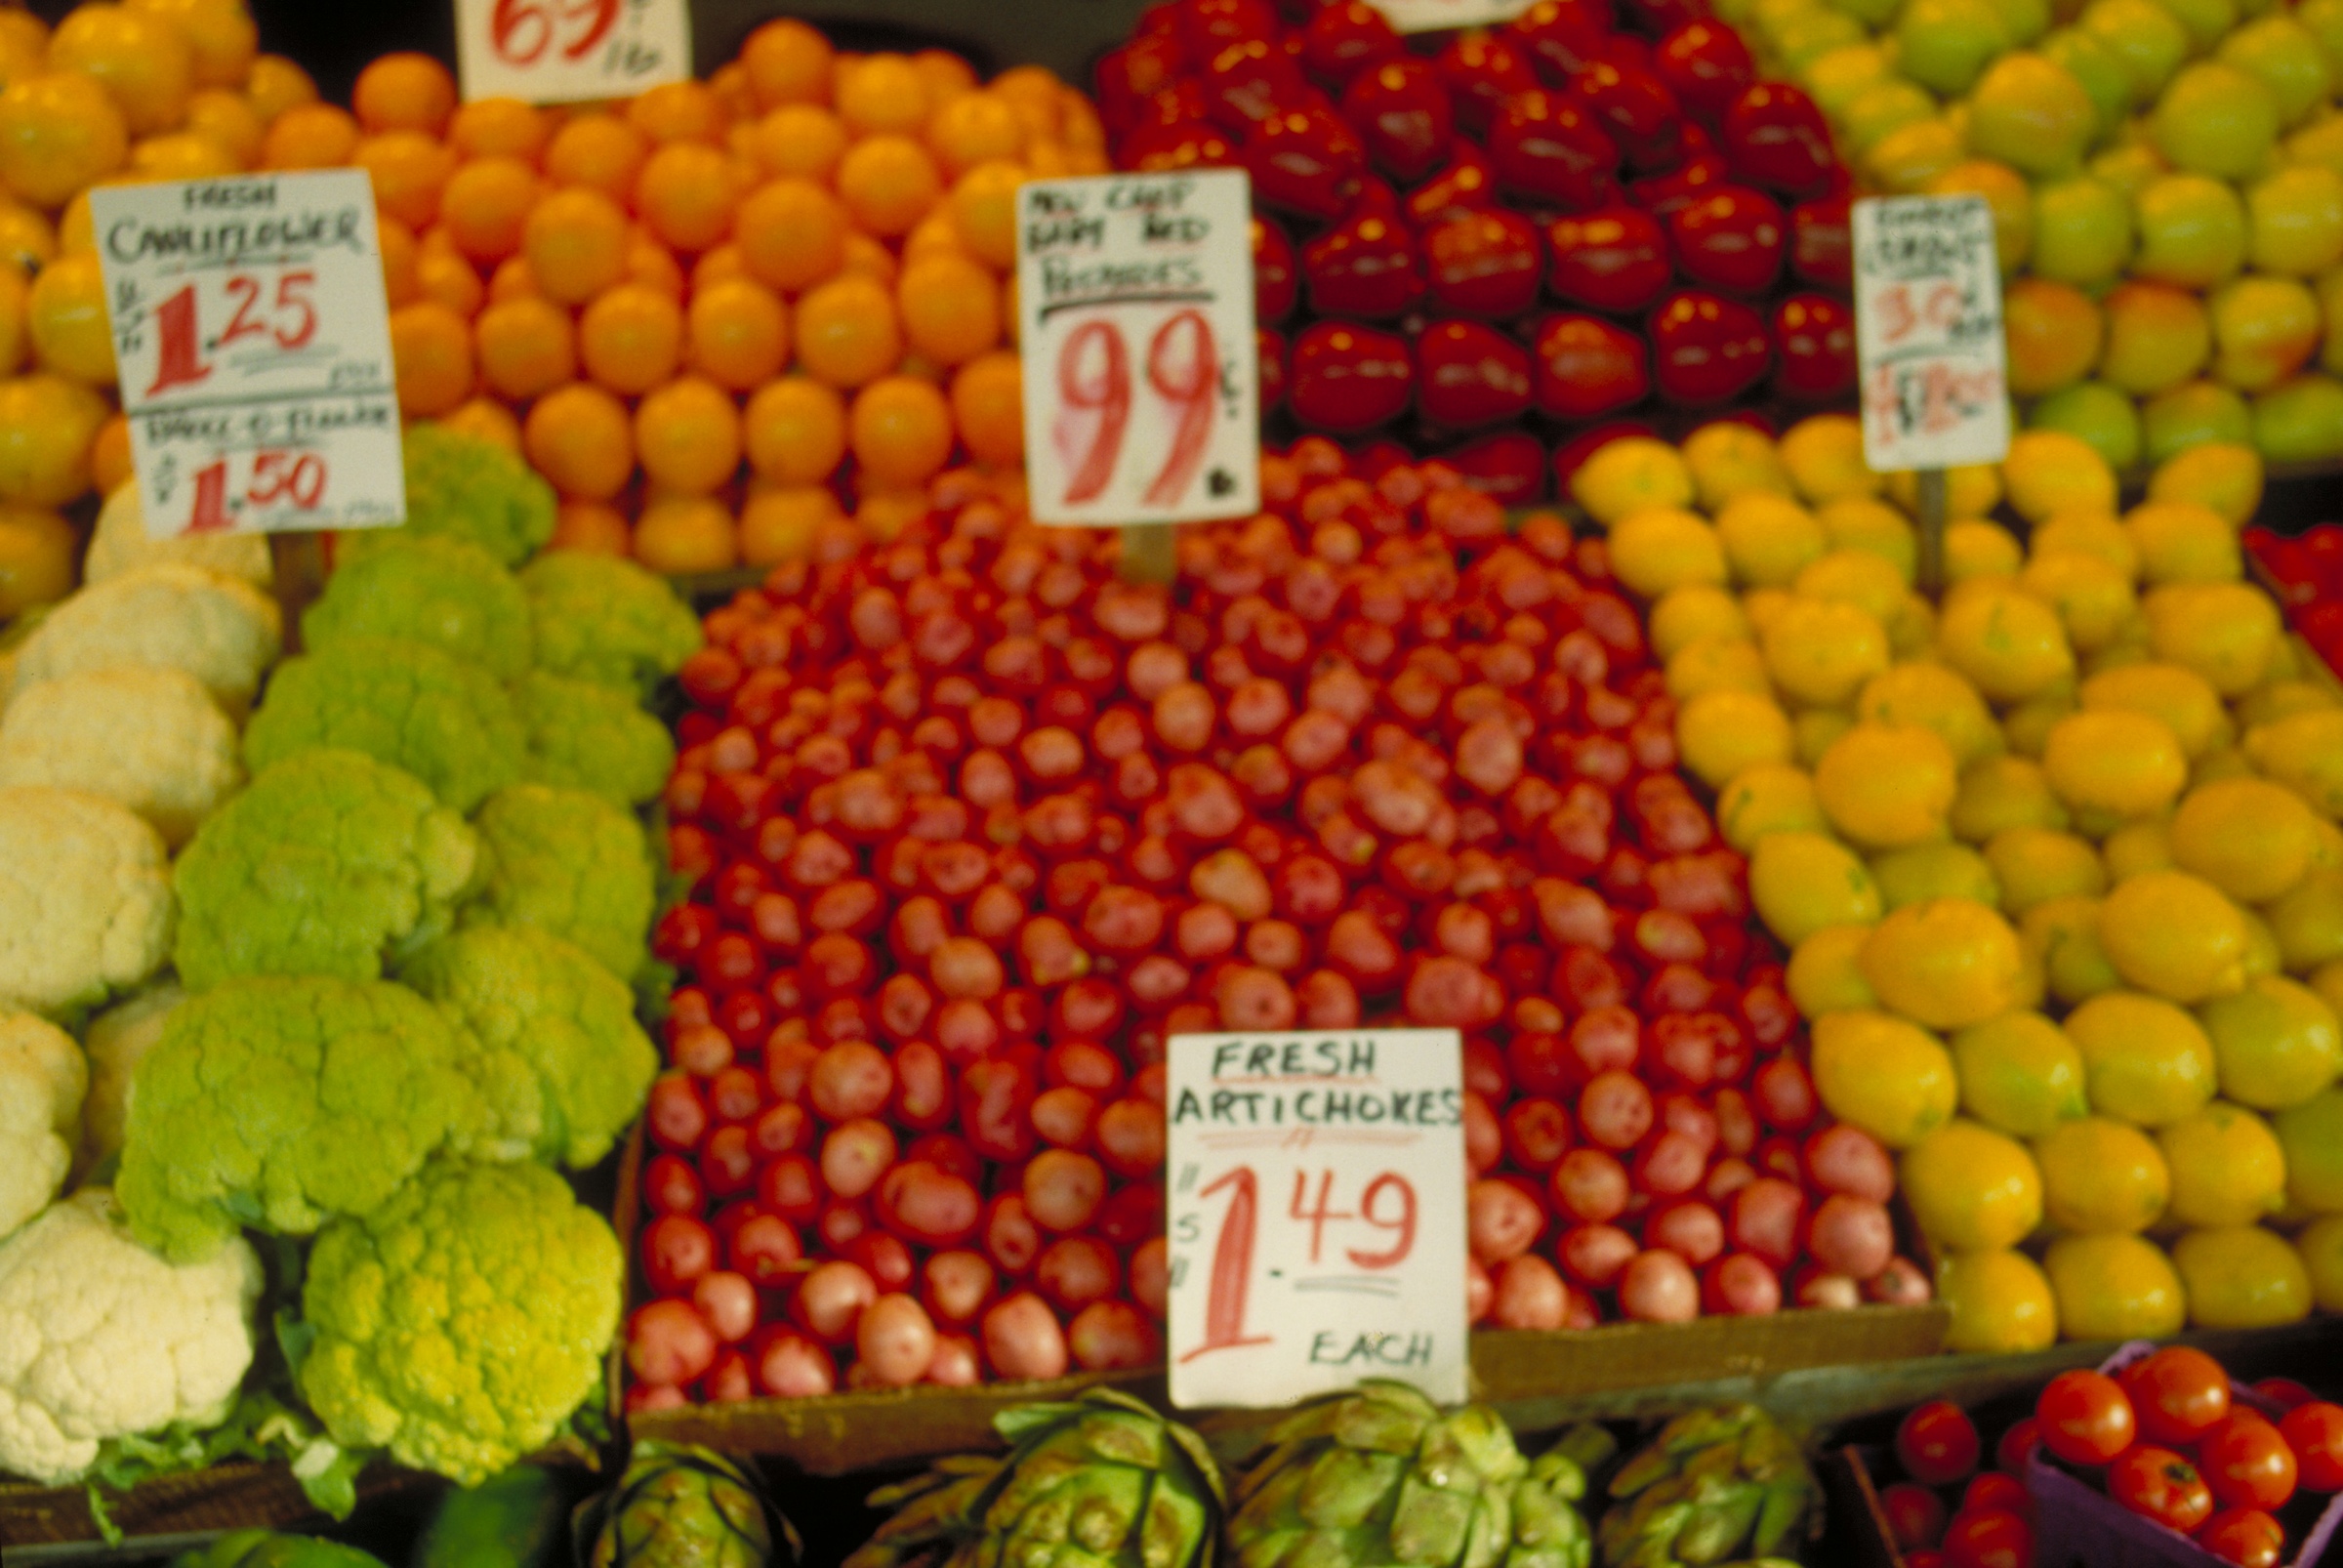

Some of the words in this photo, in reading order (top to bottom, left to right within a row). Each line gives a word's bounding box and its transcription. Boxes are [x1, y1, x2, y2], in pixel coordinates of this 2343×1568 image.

[183, 182, 277, 211] FRESH
[1212, 1039, 1377, 1076] FRESH
[1173, 1085, 1462, 1127] ARTICHOKES
[1308, 1329, 1433, 1365] EACH
